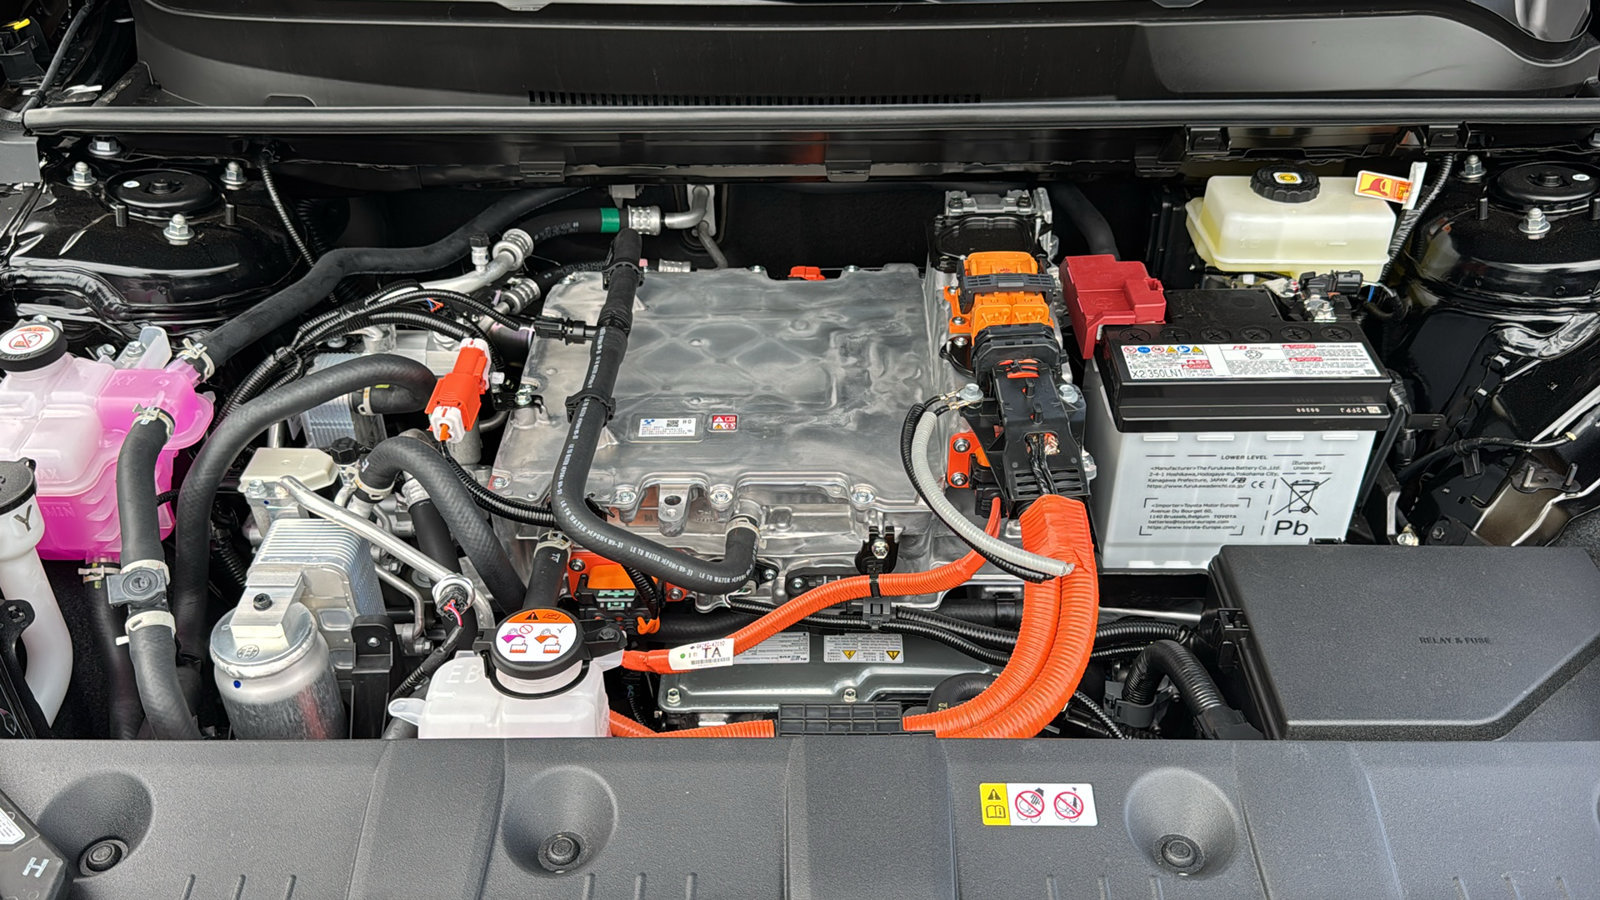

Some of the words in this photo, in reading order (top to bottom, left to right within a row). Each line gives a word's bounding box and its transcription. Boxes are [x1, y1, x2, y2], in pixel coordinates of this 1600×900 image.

[13, 504, 33, 532] Y
[569, 514, 587, 533] WATER
[1273, 520, 1309, 536] Pb
[644, 552, 661, 562] WATER
[713, 576, 731, 584] WATER
[1419, 636, 1452, 644] RELAY
[1454, 636, 1463, 644] &
[702, 647, 722, 659] TA
[445, 664, 482, 683] EB
[22, 857, 49, 878] H
